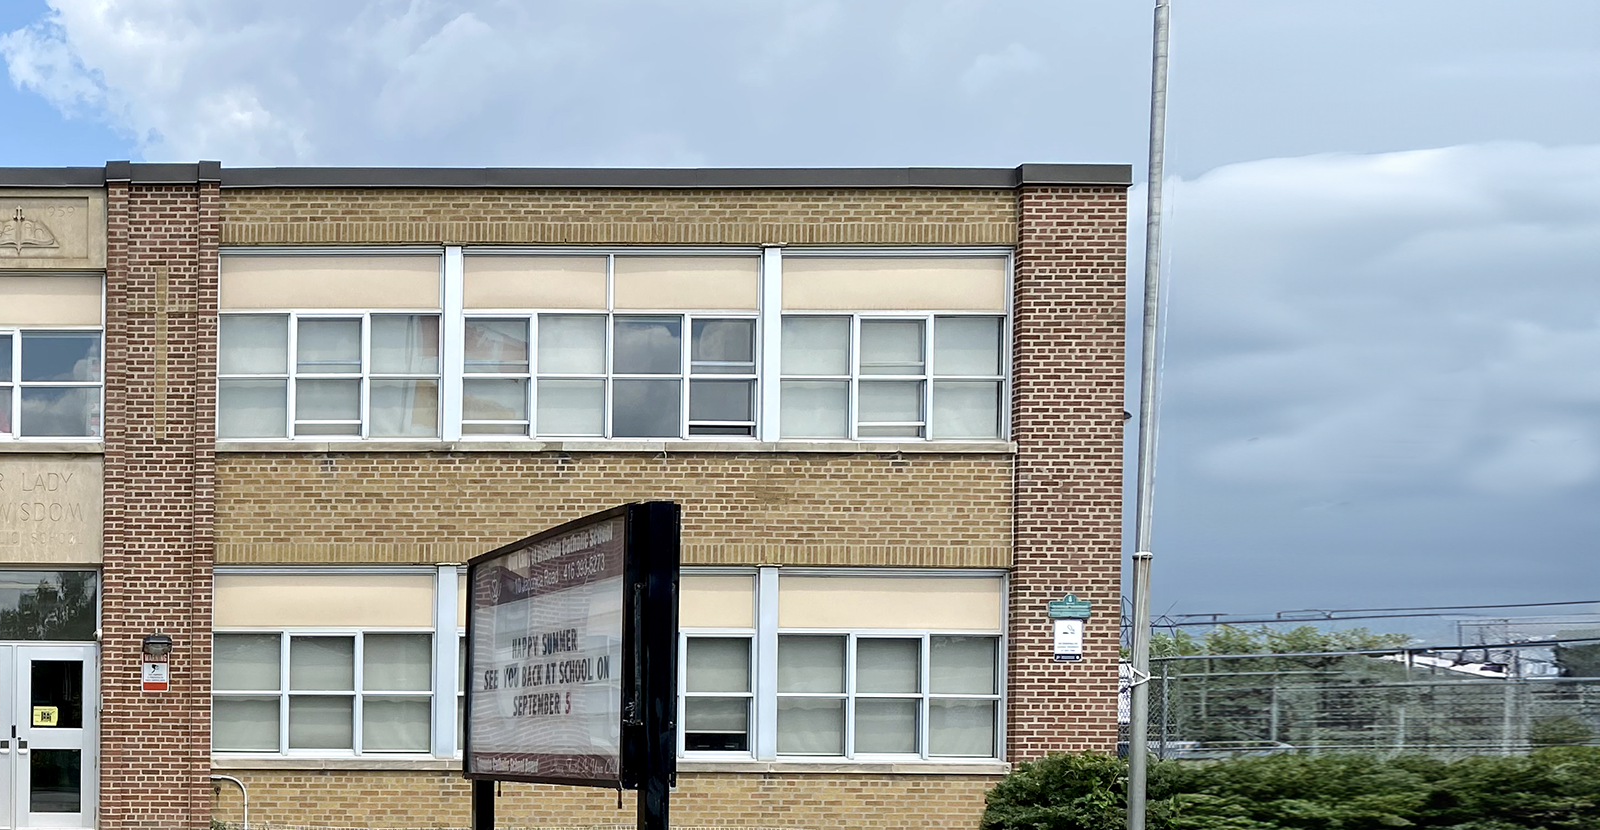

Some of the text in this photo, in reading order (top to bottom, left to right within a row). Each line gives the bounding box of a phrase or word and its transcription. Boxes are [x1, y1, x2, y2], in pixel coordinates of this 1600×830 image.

[21, 472, 74, 492] LADY
[31, 531, 83, 545] SCHOOL
[544, 569, 559, 586] Road
[563, 561, 575, 580] 416
[512, 628, 578, 659] HAPPY SUMMER
[484, 655, 610, 690] SEE YOU BACK AT SCHOOL ON
[513, 692, 571, 716] SEPTEMBER 5
